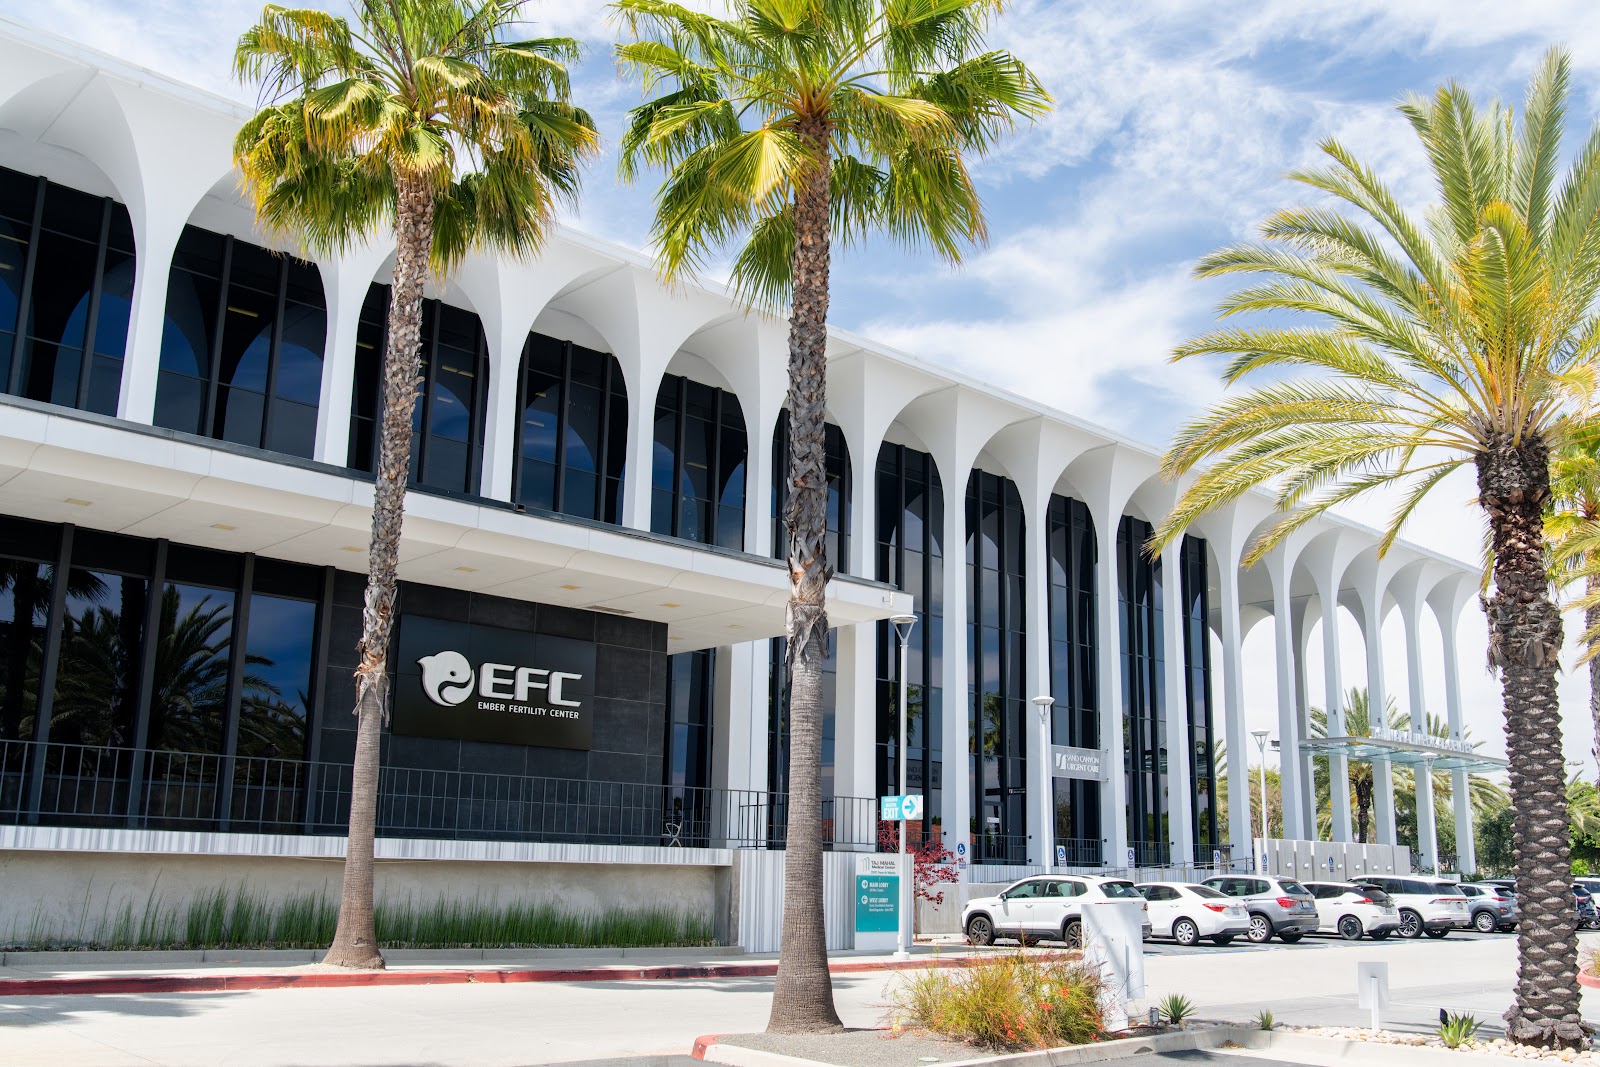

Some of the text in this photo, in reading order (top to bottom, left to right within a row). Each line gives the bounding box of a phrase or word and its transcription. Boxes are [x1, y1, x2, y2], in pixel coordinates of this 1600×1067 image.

[478, 663, 583, 707] EFC
[478, 702, 579, 719] EMBER FERTILITY CENTER
[884, 808, 898, 818] EXIT
